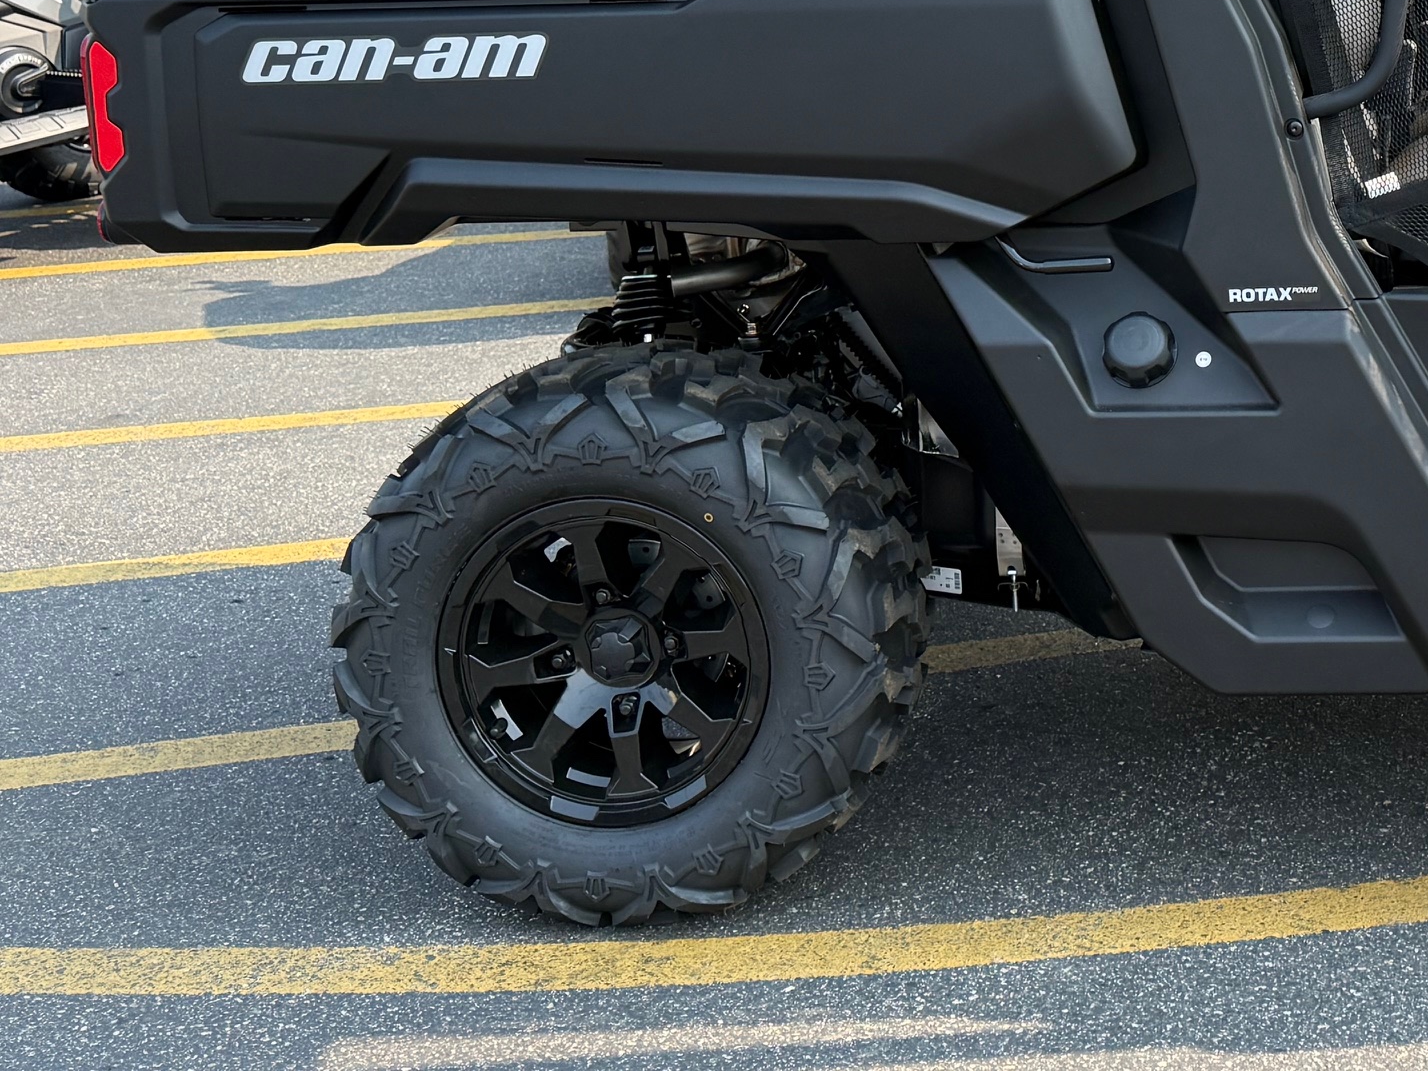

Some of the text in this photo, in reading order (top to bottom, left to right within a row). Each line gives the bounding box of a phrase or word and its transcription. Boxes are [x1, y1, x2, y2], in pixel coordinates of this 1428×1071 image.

[242, 34, 547, 83] can-am
[1228, 286, 1318, 303] ROTAX POWER
